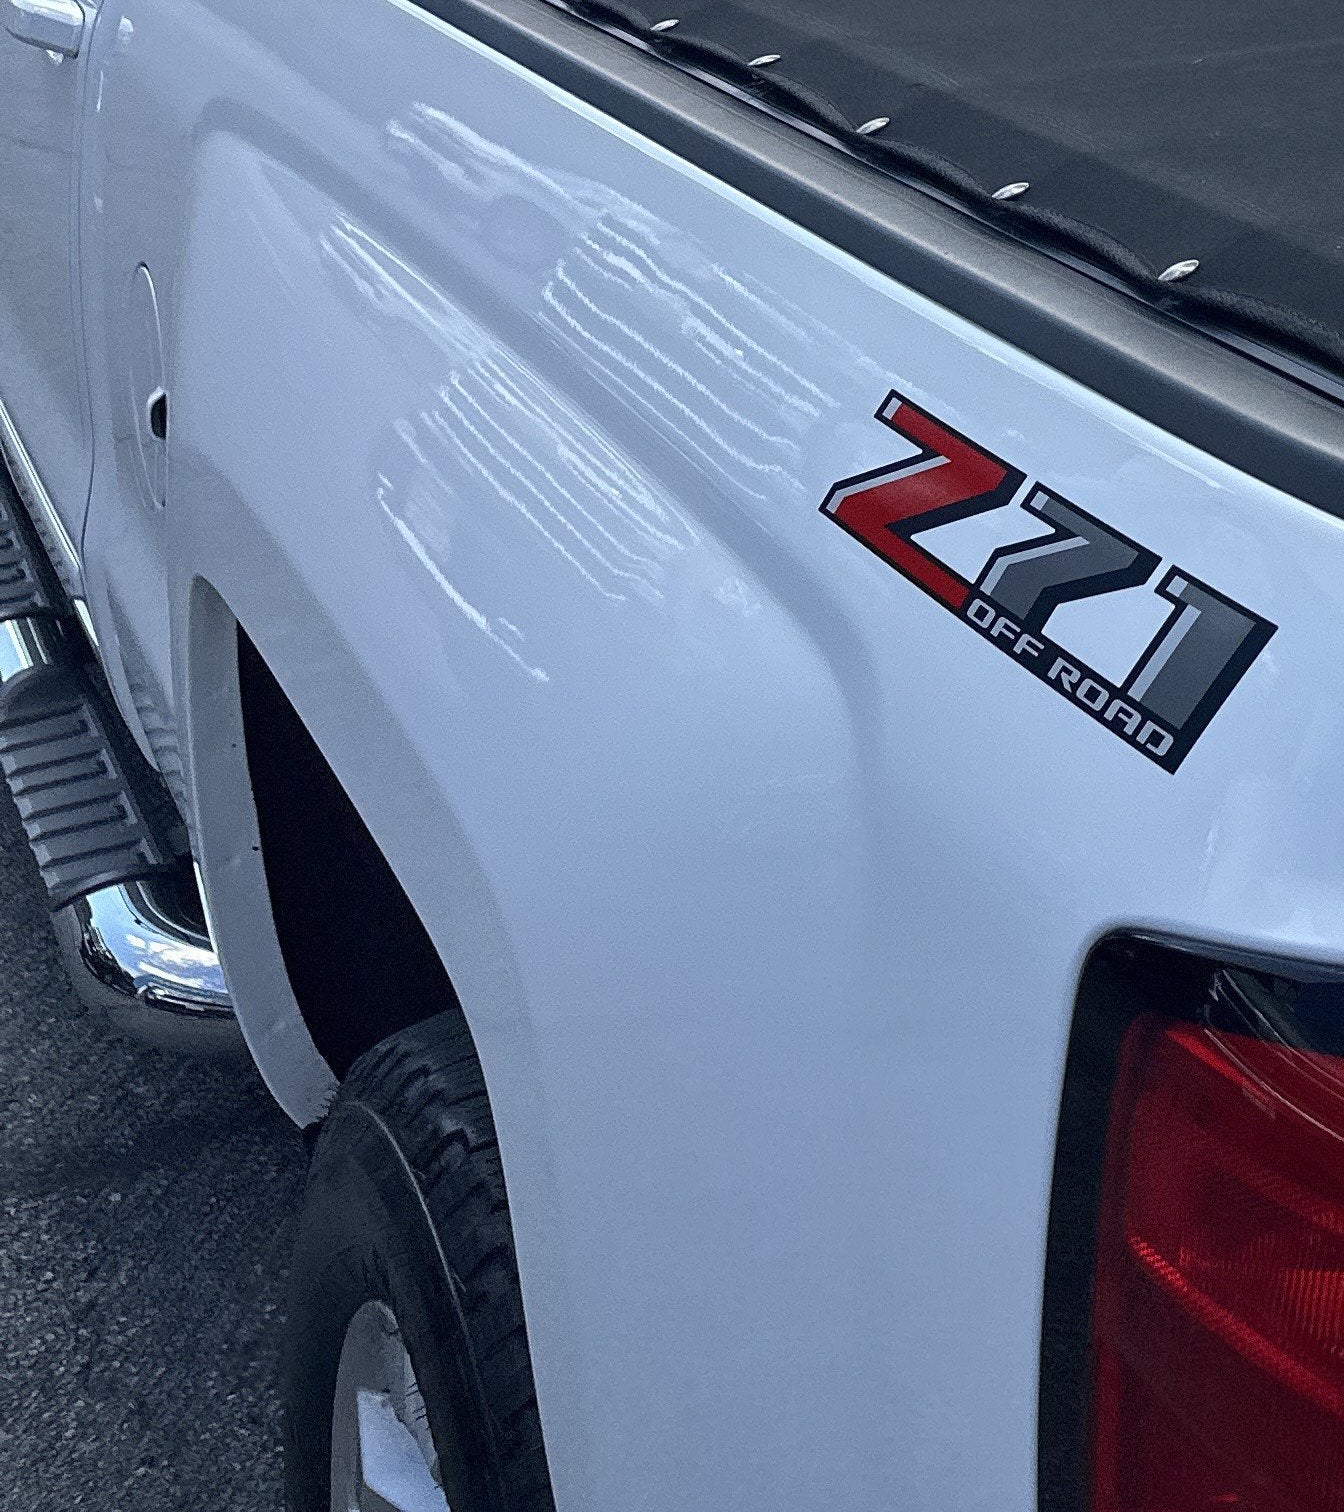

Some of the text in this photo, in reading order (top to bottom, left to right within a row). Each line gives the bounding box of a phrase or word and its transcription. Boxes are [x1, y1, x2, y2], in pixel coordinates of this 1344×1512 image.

[819, 388, 1279, 738] Z71
[965, 597, 1177, 759] OFF ROAD
